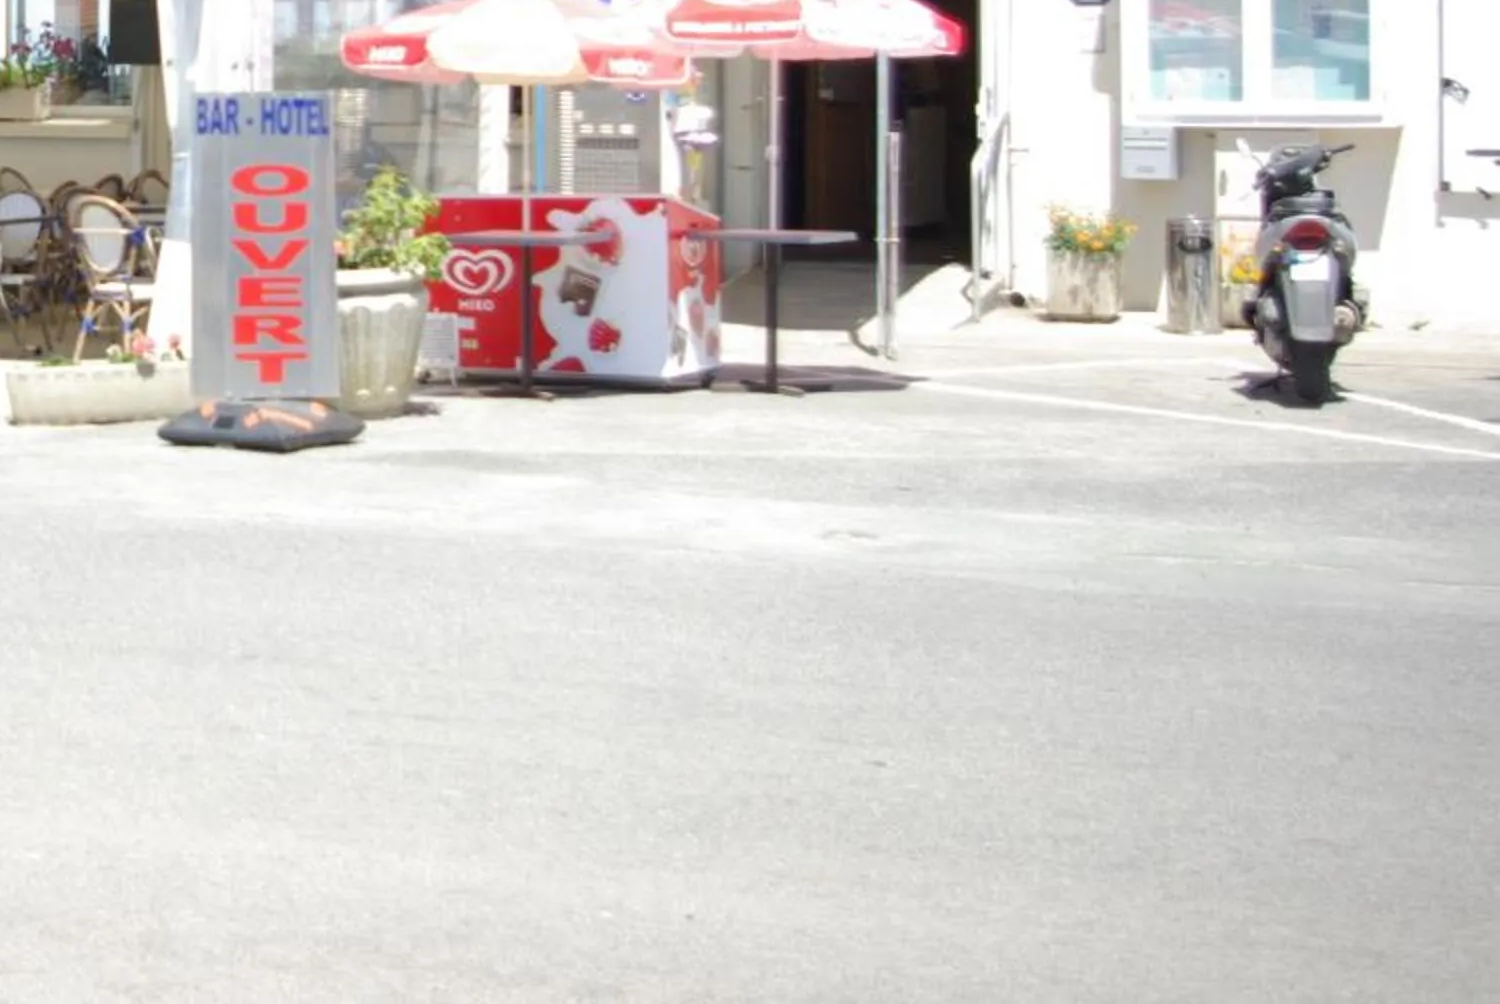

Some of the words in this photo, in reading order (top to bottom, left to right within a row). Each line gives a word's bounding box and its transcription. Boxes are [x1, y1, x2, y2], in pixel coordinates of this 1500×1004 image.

[197, 98, 239, 135] BAR
[261, 98, 330, 136] HOTEL
[230, 164, 311, 384] OUVERT
